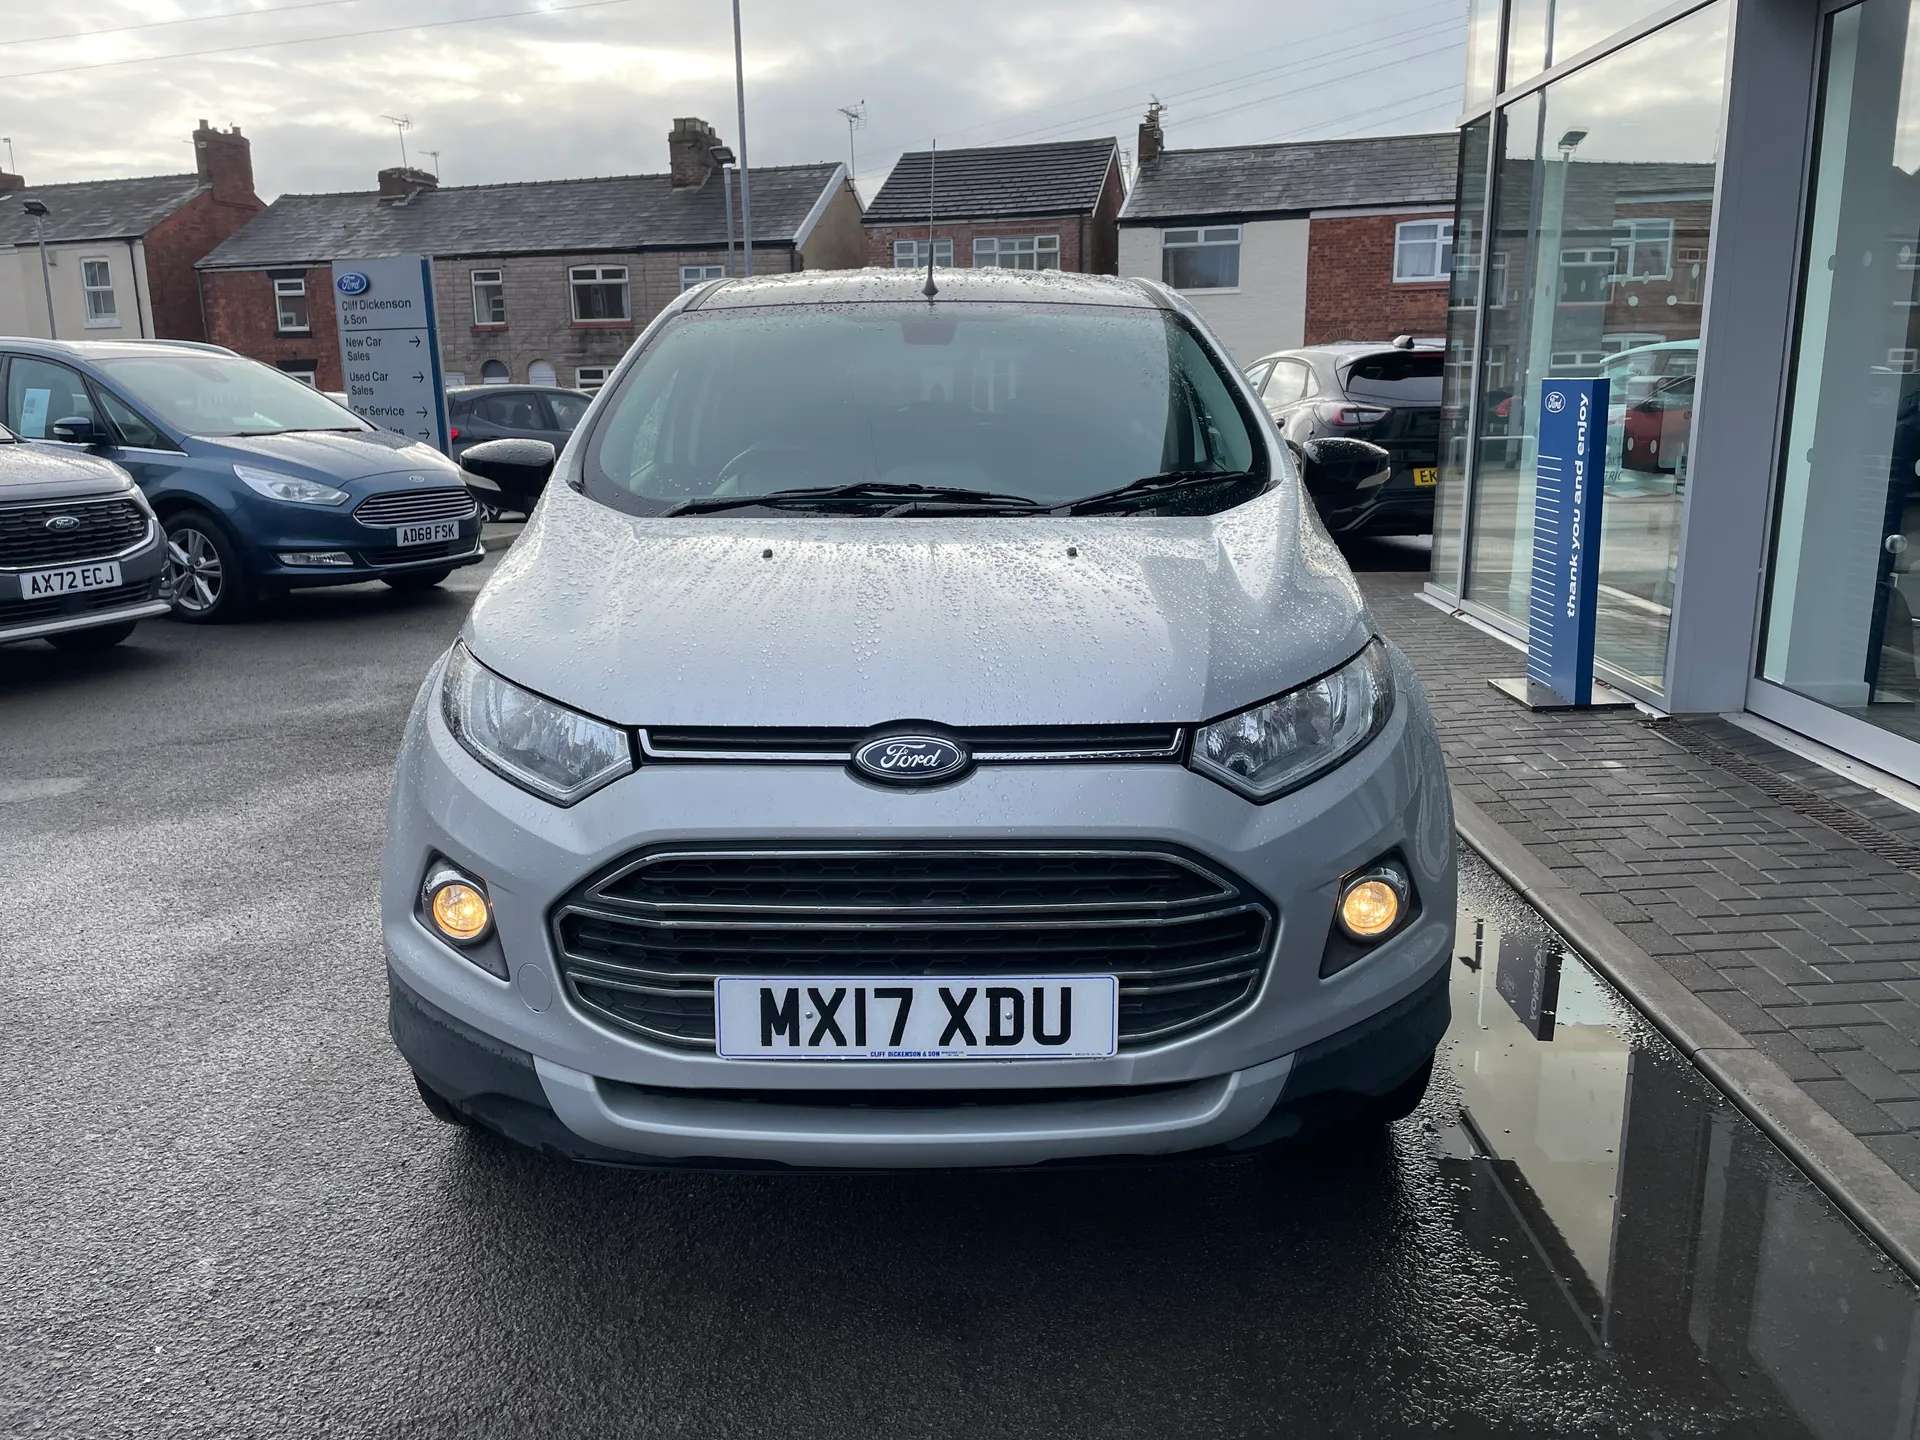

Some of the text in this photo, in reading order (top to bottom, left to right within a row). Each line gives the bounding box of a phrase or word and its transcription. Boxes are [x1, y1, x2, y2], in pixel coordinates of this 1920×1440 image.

[341, 275, 361, 291] Ford
[342, 299, 412, 311] Cliff Dickenson
[343, 314, 368, 325] & Son
[345, 336, 382, 347] New Car
[347, 351, 370, 361] Sales
[350, 371, 389, 381] Used Car
[351, 385, 374, 395] Sales
[369, 405, 405, 416] Service
[1567, 392, 1589, 618] thank you and enjoy
[403, 524, 455, 543] AD68 FSK
[31, 565, 115, 595] AX72 ECJ
[880, 743, 941, 768] Ford
[759, 986, 1072, 1047] MX17 XDU
[928, 1050, 940, 1058] SON
